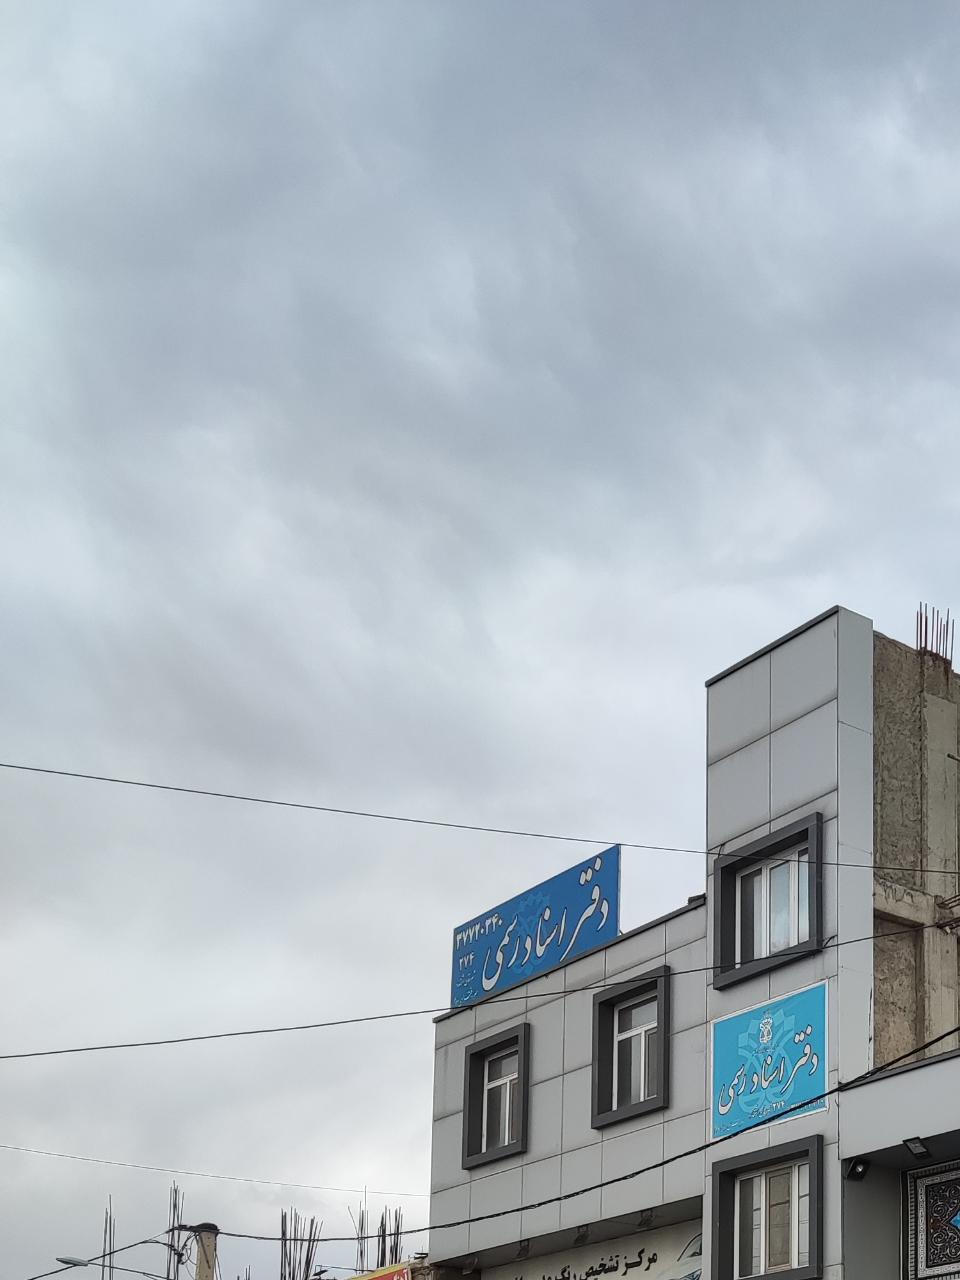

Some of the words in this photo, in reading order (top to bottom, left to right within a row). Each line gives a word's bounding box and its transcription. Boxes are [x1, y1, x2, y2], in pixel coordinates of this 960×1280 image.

[521, 906, 567, 966] اسناد
[560, 856, 609, 963] دفتر
[482, 914, 519, 991] رسمی
[718, 1064, 747, 1115] رسمی
[750, 1054, 785, 1095] اسناد
[780, 1024, 819, 1095] دفتر
[622, 1248, 658, 1276] مرکز
